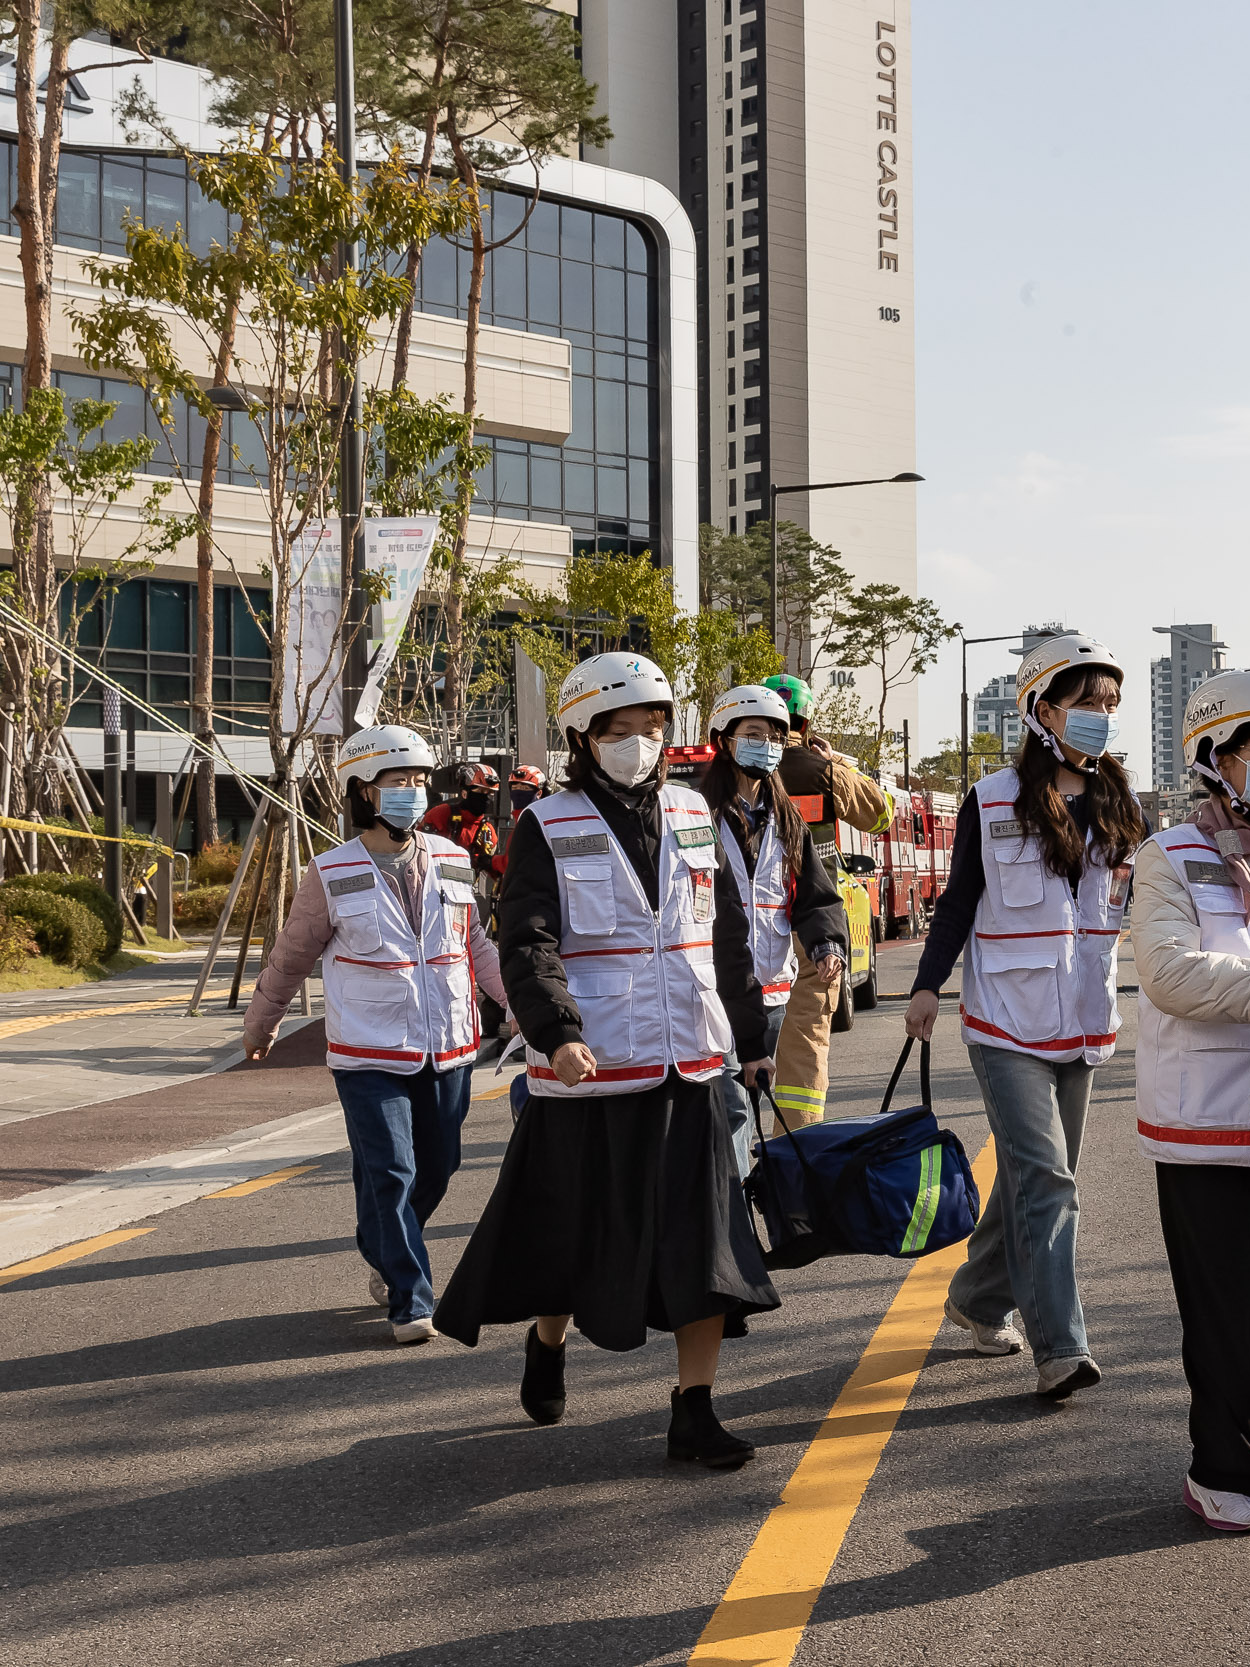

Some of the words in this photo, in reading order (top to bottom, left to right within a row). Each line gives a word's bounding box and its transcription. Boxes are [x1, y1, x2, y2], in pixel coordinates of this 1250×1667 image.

[875, 20, 897, 134] LOTTE
[876, 139, 899, 273] CASTLE
[878, 306, 901, 323] 105
[828, 670, 856, 687] 104
[563, 837, 598, 850] 광진구보건소
